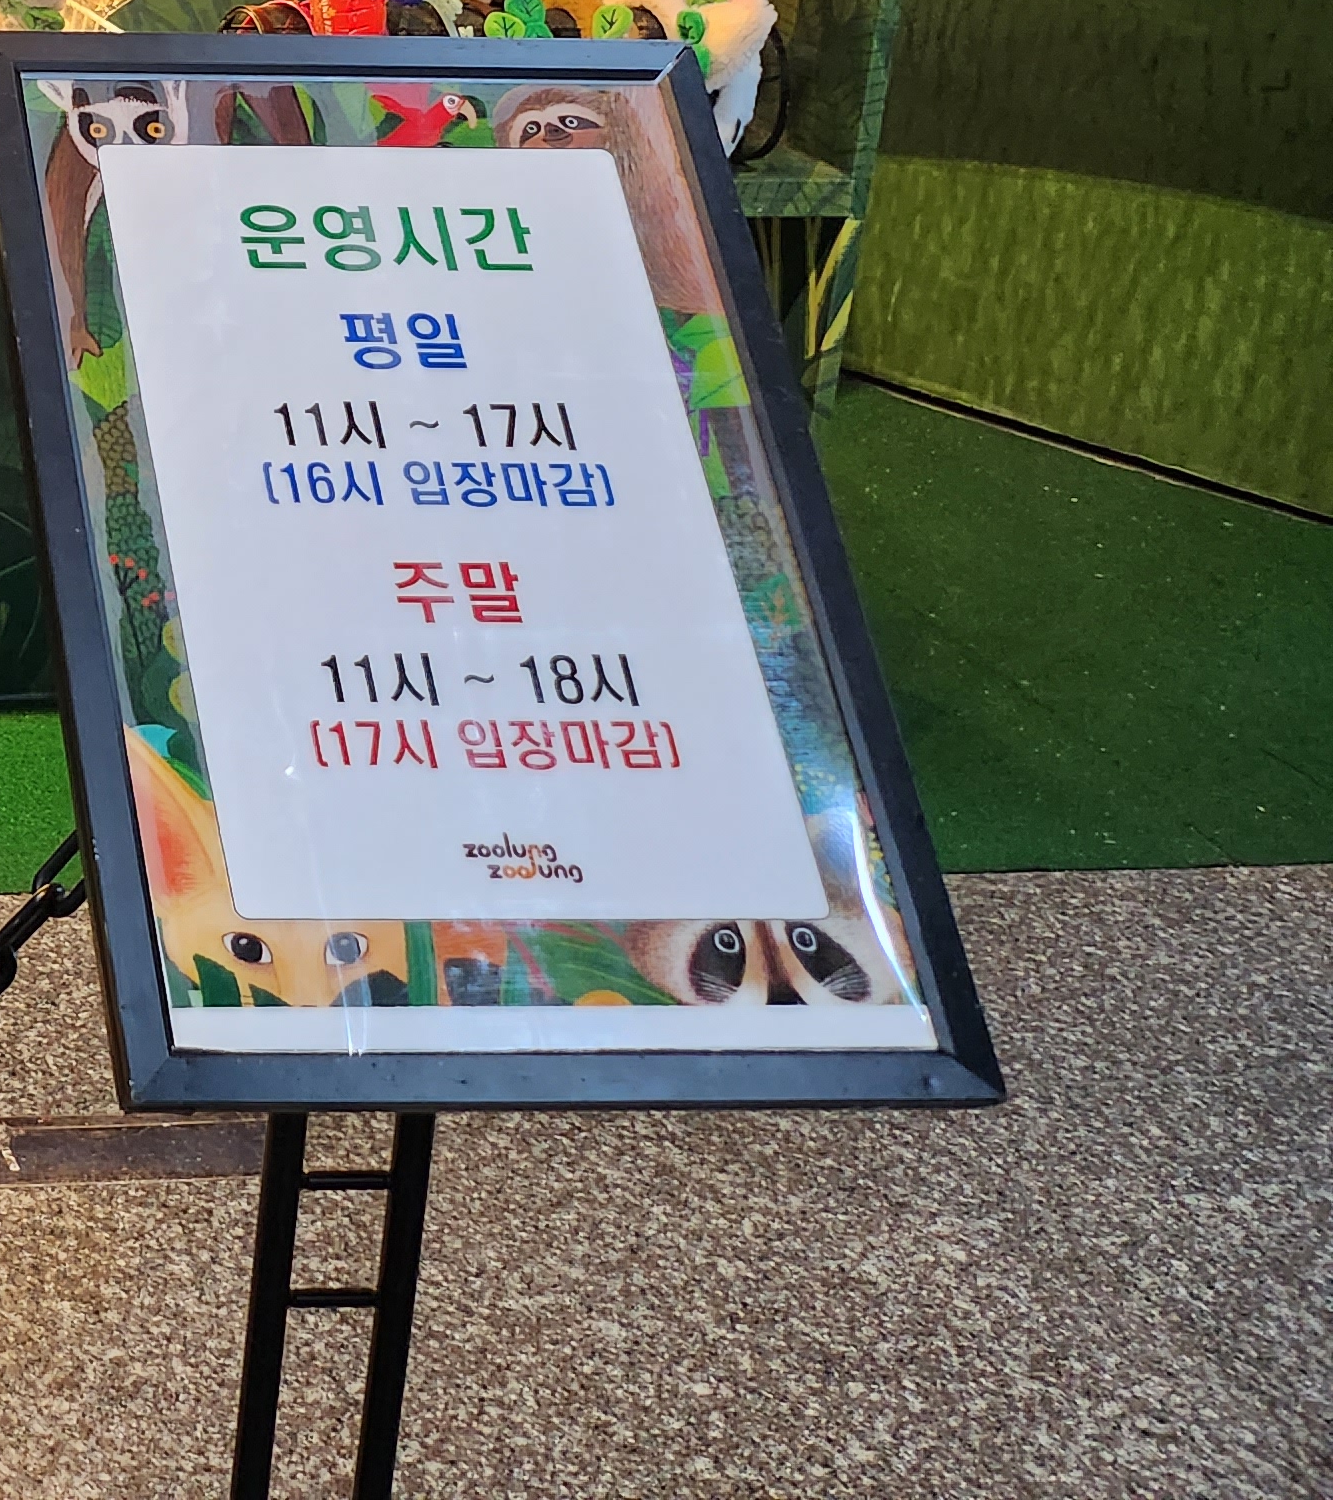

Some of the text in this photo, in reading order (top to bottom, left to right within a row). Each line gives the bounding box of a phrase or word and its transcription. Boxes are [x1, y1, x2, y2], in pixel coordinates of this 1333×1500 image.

[238, 204, 533, 274] 운영시간
[340, 312, 468, 372] 평일
[273, 401, 384, 451] 11시
[463, 402, 578, 452] 17시
[262, 460, 616, 508] (16시 입장마감)
[393, 559, 524, 626] 주말
[320, 654, 440, 707] 11시
[520, 654, 641, 708] 18시
[311, 720, 680, 772] (17시 입장마감)
[462, 832, 558, 862] zoolung
[486, 864, 584, 883] zoolung
